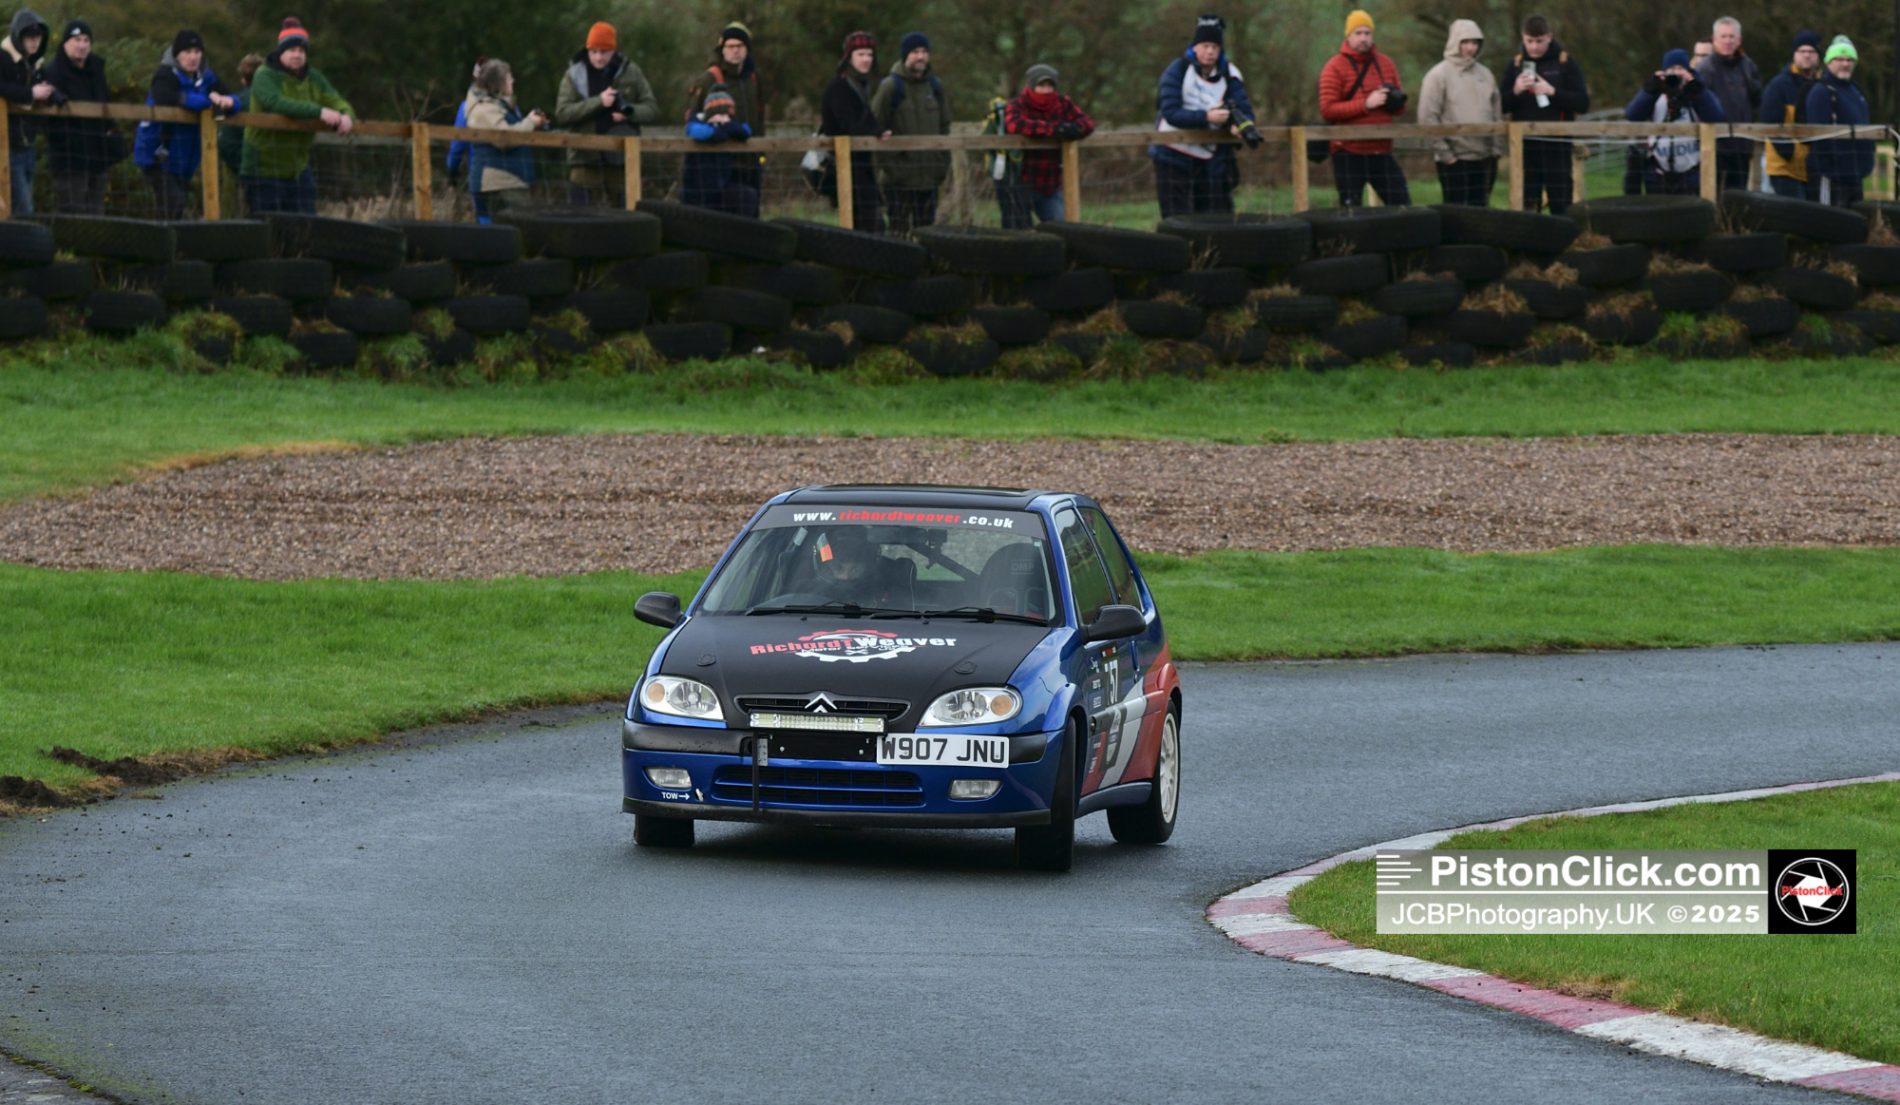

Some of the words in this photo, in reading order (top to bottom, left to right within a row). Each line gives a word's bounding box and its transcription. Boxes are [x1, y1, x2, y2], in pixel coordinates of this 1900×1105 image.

[881, 737, 948, 761] W907
[956, 739, 1005, 764] JNU
[661, 791, 679, 800] TOW
